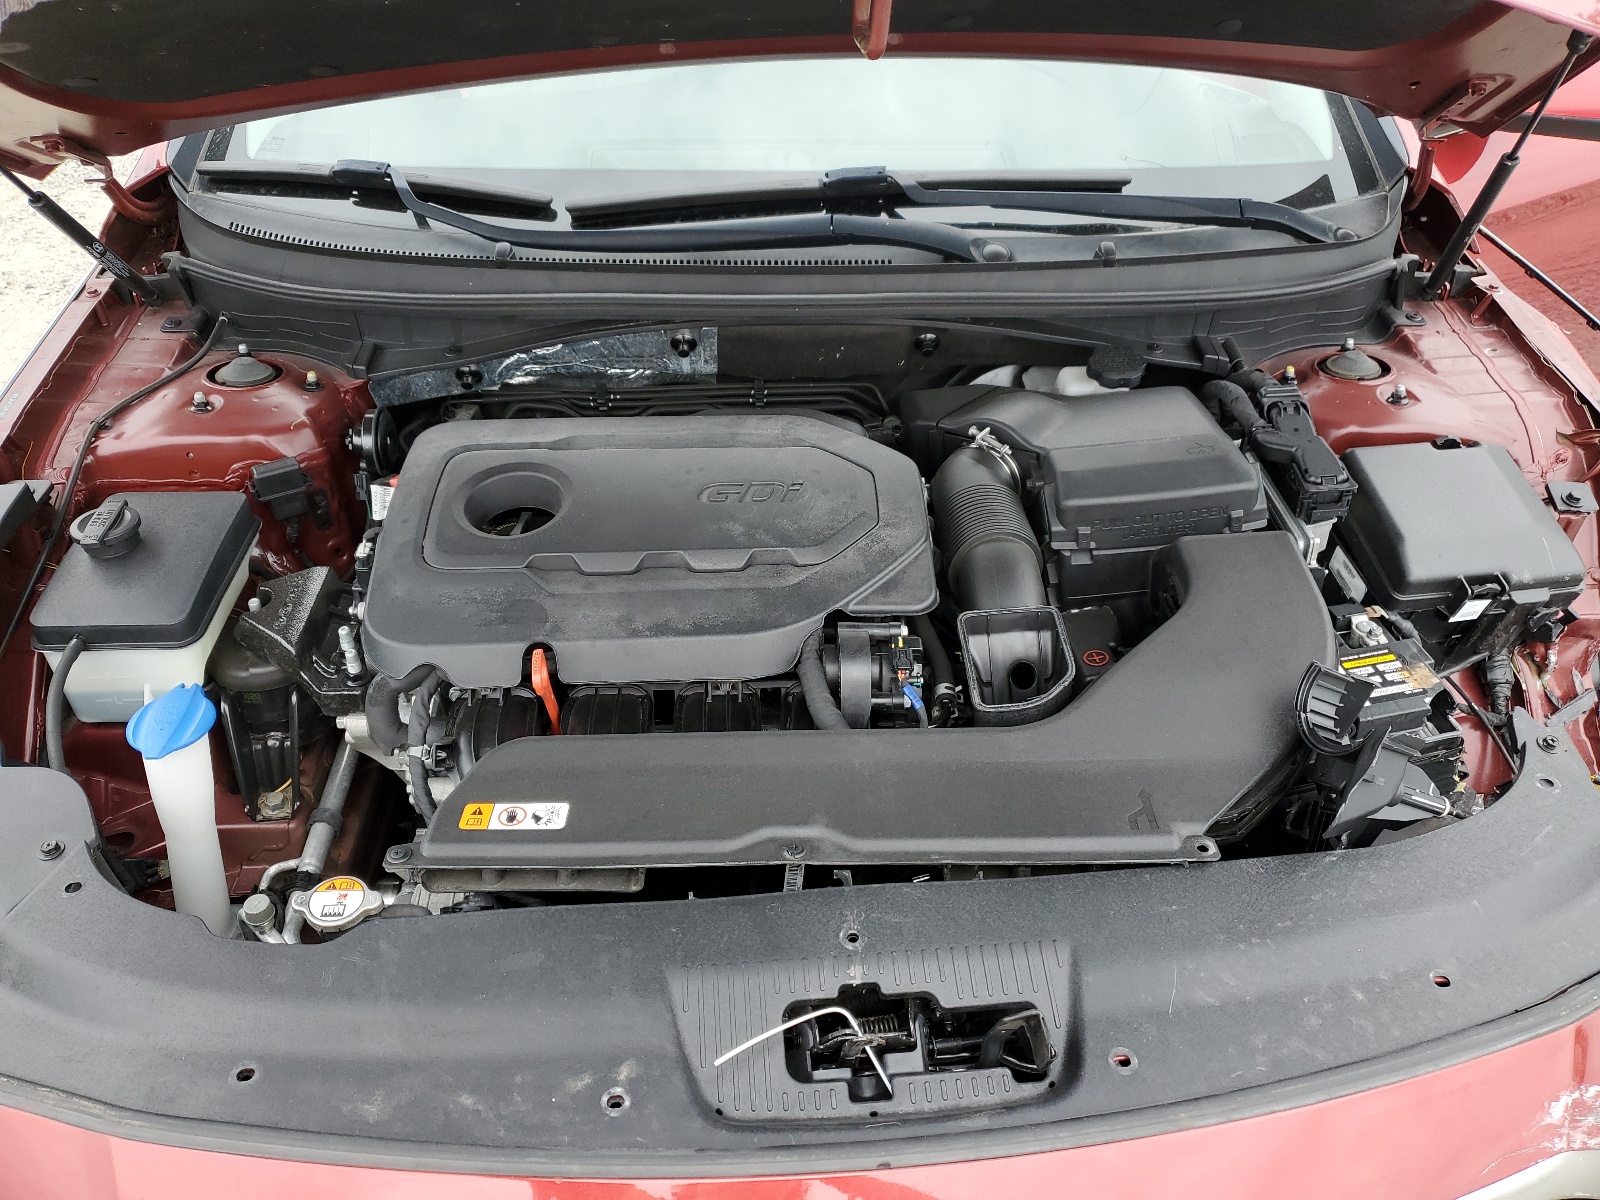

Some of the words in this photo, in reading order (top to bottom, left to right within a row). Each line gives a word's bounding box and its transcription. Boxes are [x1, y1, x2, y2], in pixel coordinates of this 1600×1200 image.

[697, 480, 805, 503] GDi
[1092, 517, 1129, 530] PULL
[1133, 514, 1162, 527] OUT
[1166, 511, 1184, 523] TO
[1189, 505, 1229, 521] OPEN
